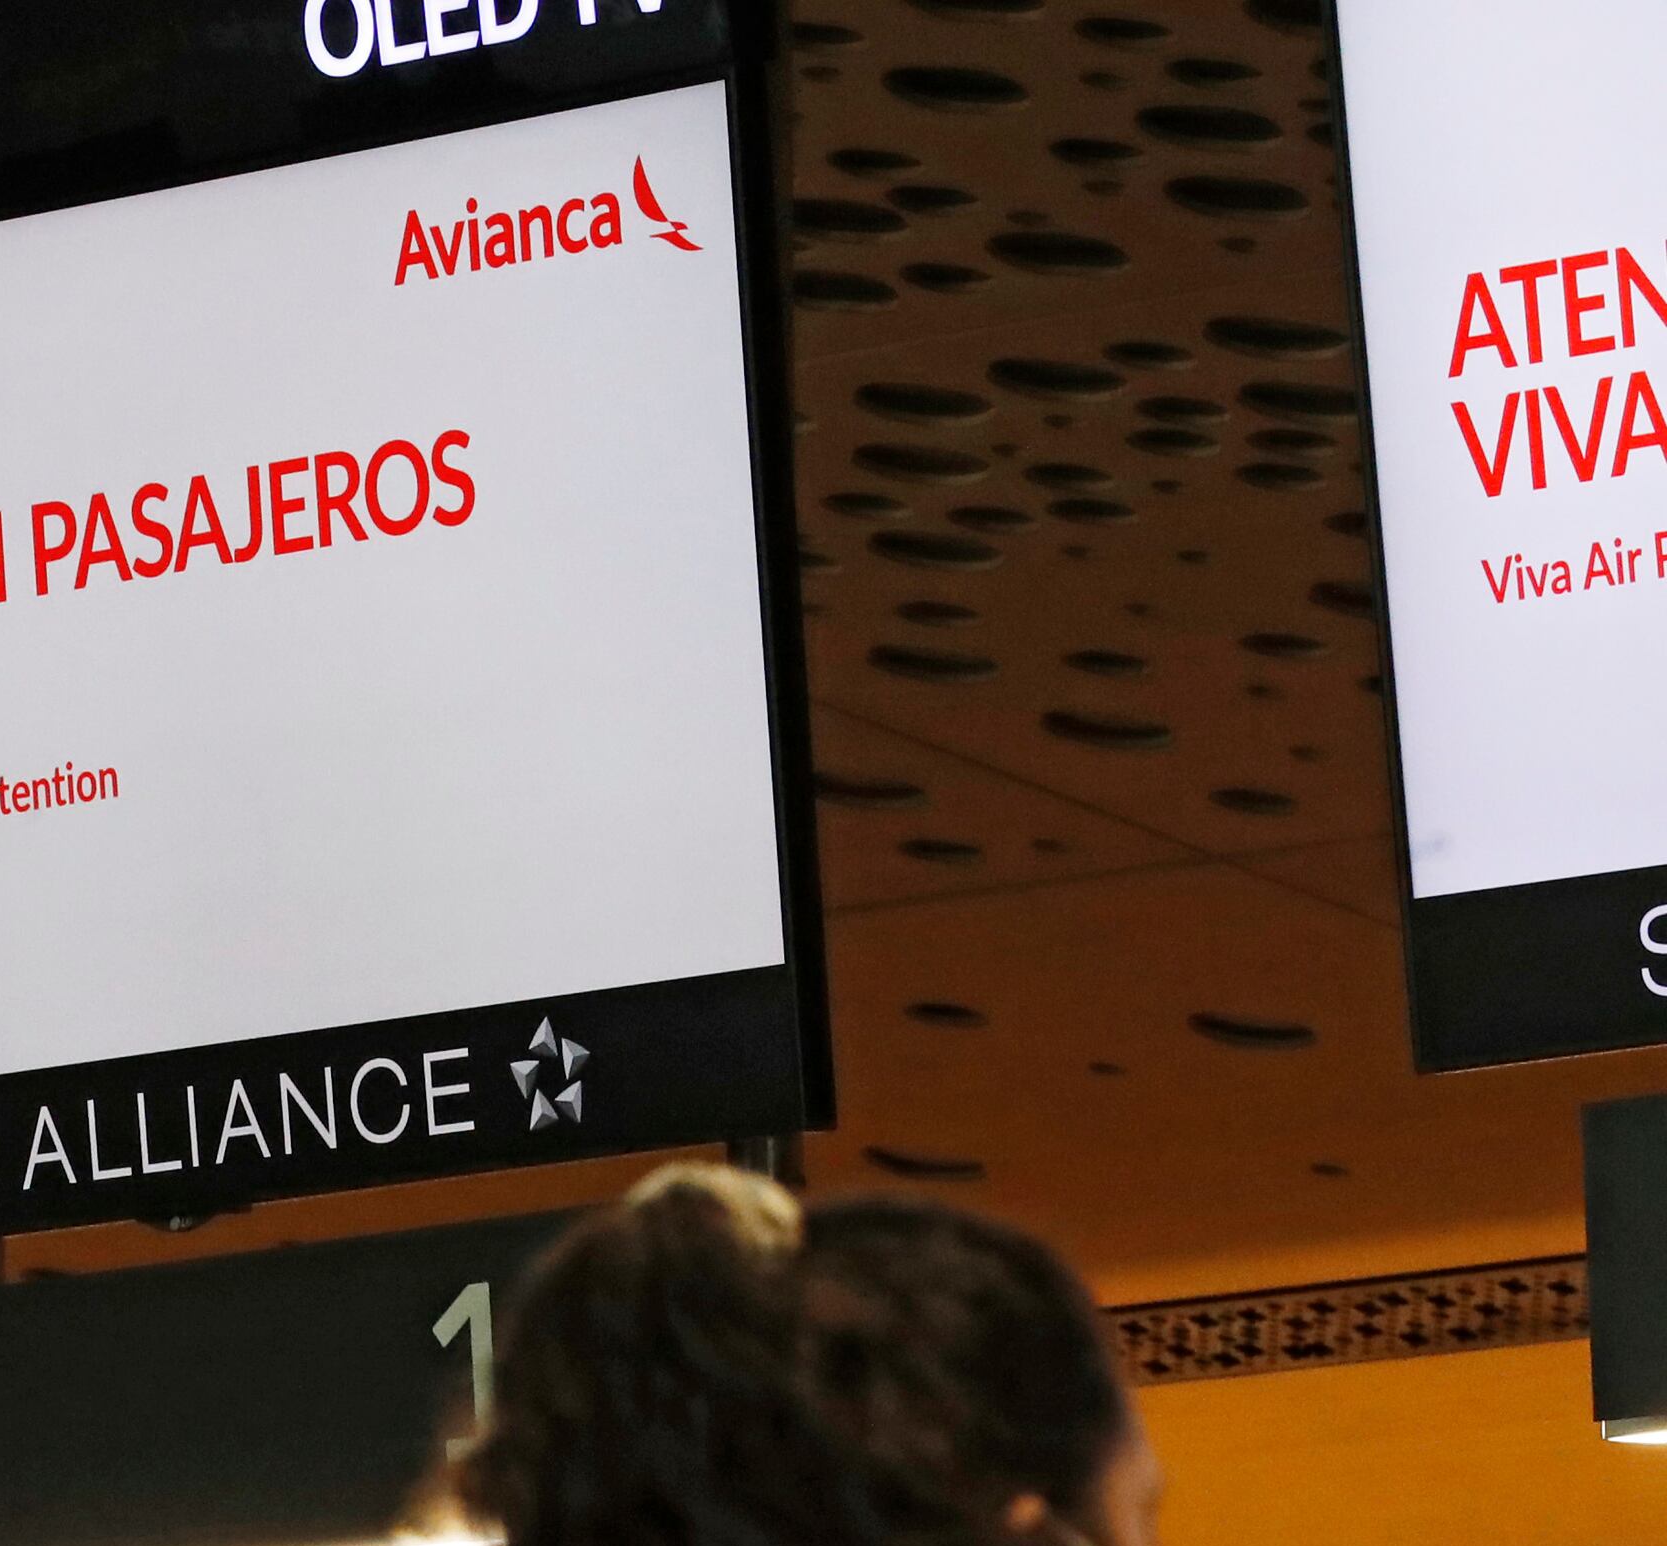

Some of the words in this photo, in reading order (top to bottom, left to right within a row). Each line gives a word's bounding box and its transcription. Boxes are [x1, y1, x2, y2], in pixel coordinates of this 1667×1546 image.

[395, 197, 622, 286] Avianca
[1451, 371, 1667, 497] VIVA
[31, 430, 476, 596] PASAJEROS
[1482, 553, 1572, 604] Viva
[1585, 537, 1642, 590] Air
[24, 1048, 474, 1190] ALLIANCE
